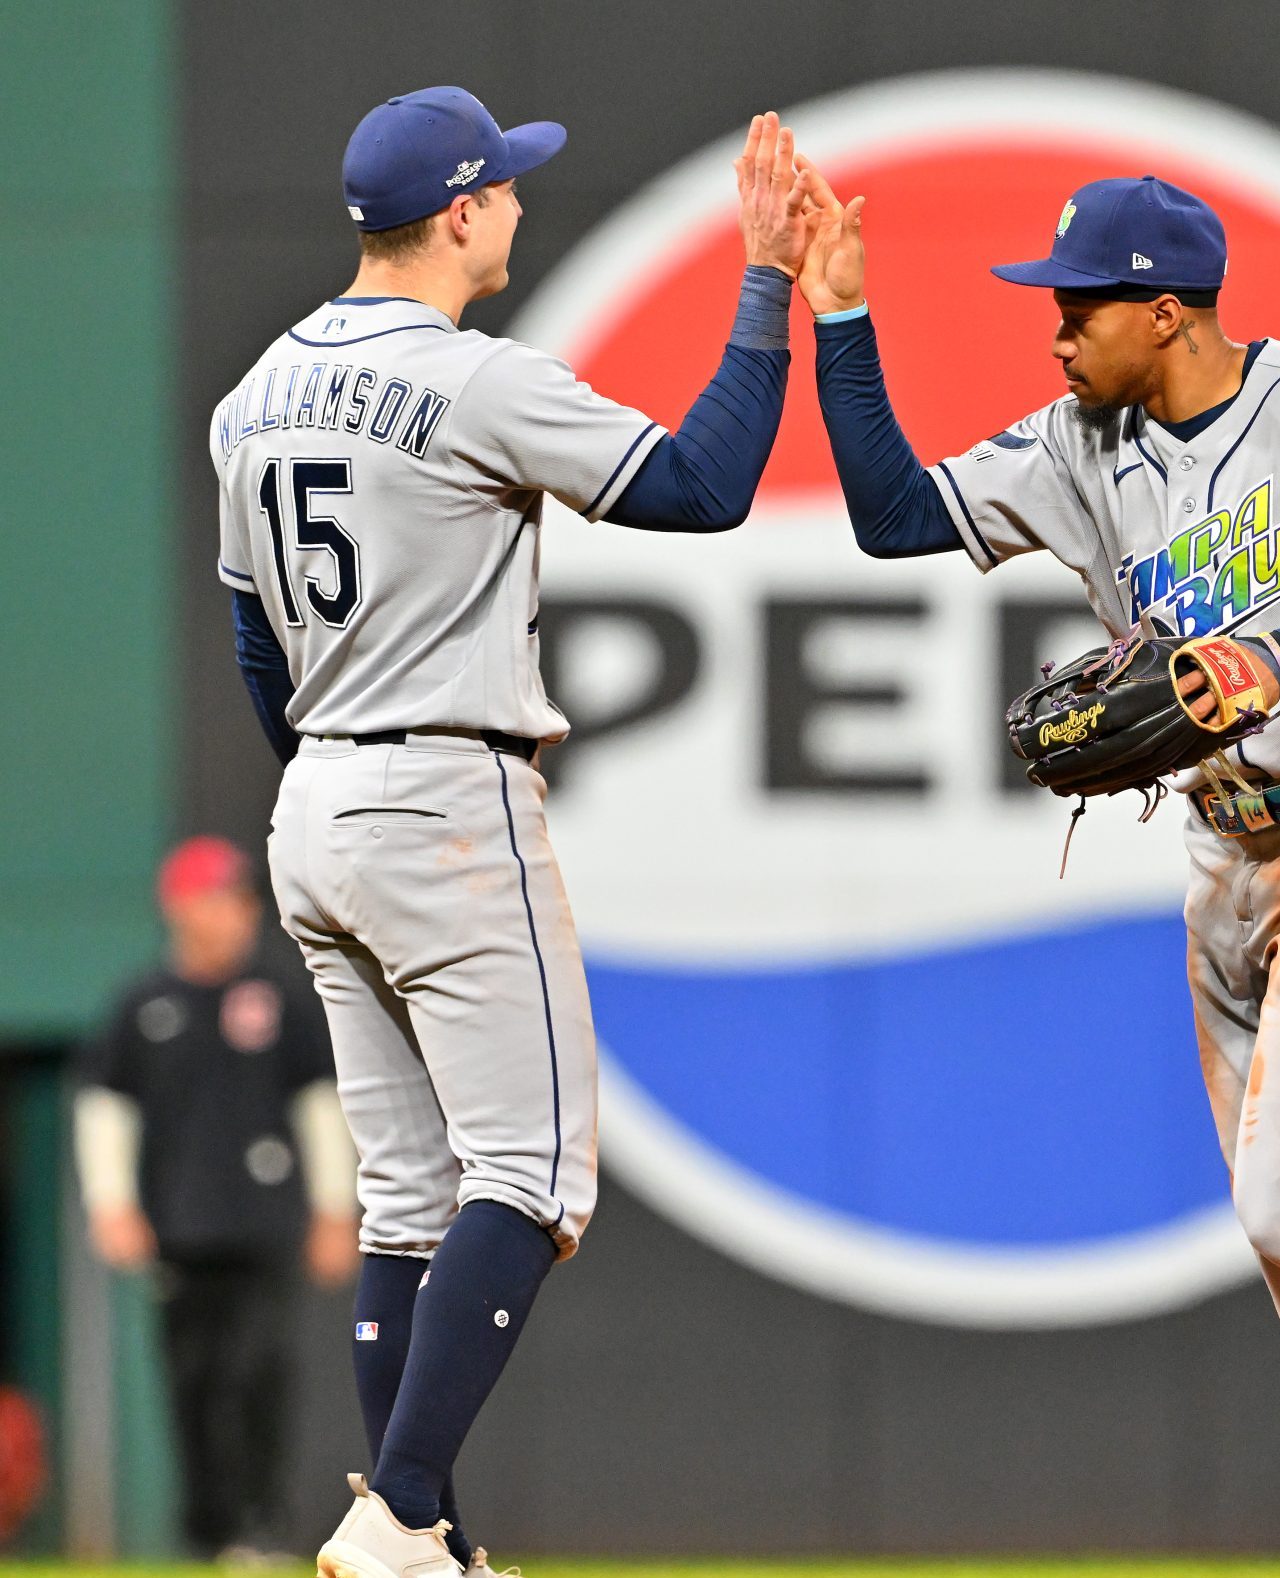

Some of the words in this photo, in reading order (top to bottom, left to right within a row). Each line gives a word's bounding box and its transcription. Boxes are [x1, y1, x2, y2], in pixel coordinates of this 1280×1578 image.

[445, 158, 486, 188] POSTSEASON
[217, 363, 450, 466] WILLIAMSON
[257, 457, 362, 630] 15
[1039, 702, 1106, 747] Rawlings
